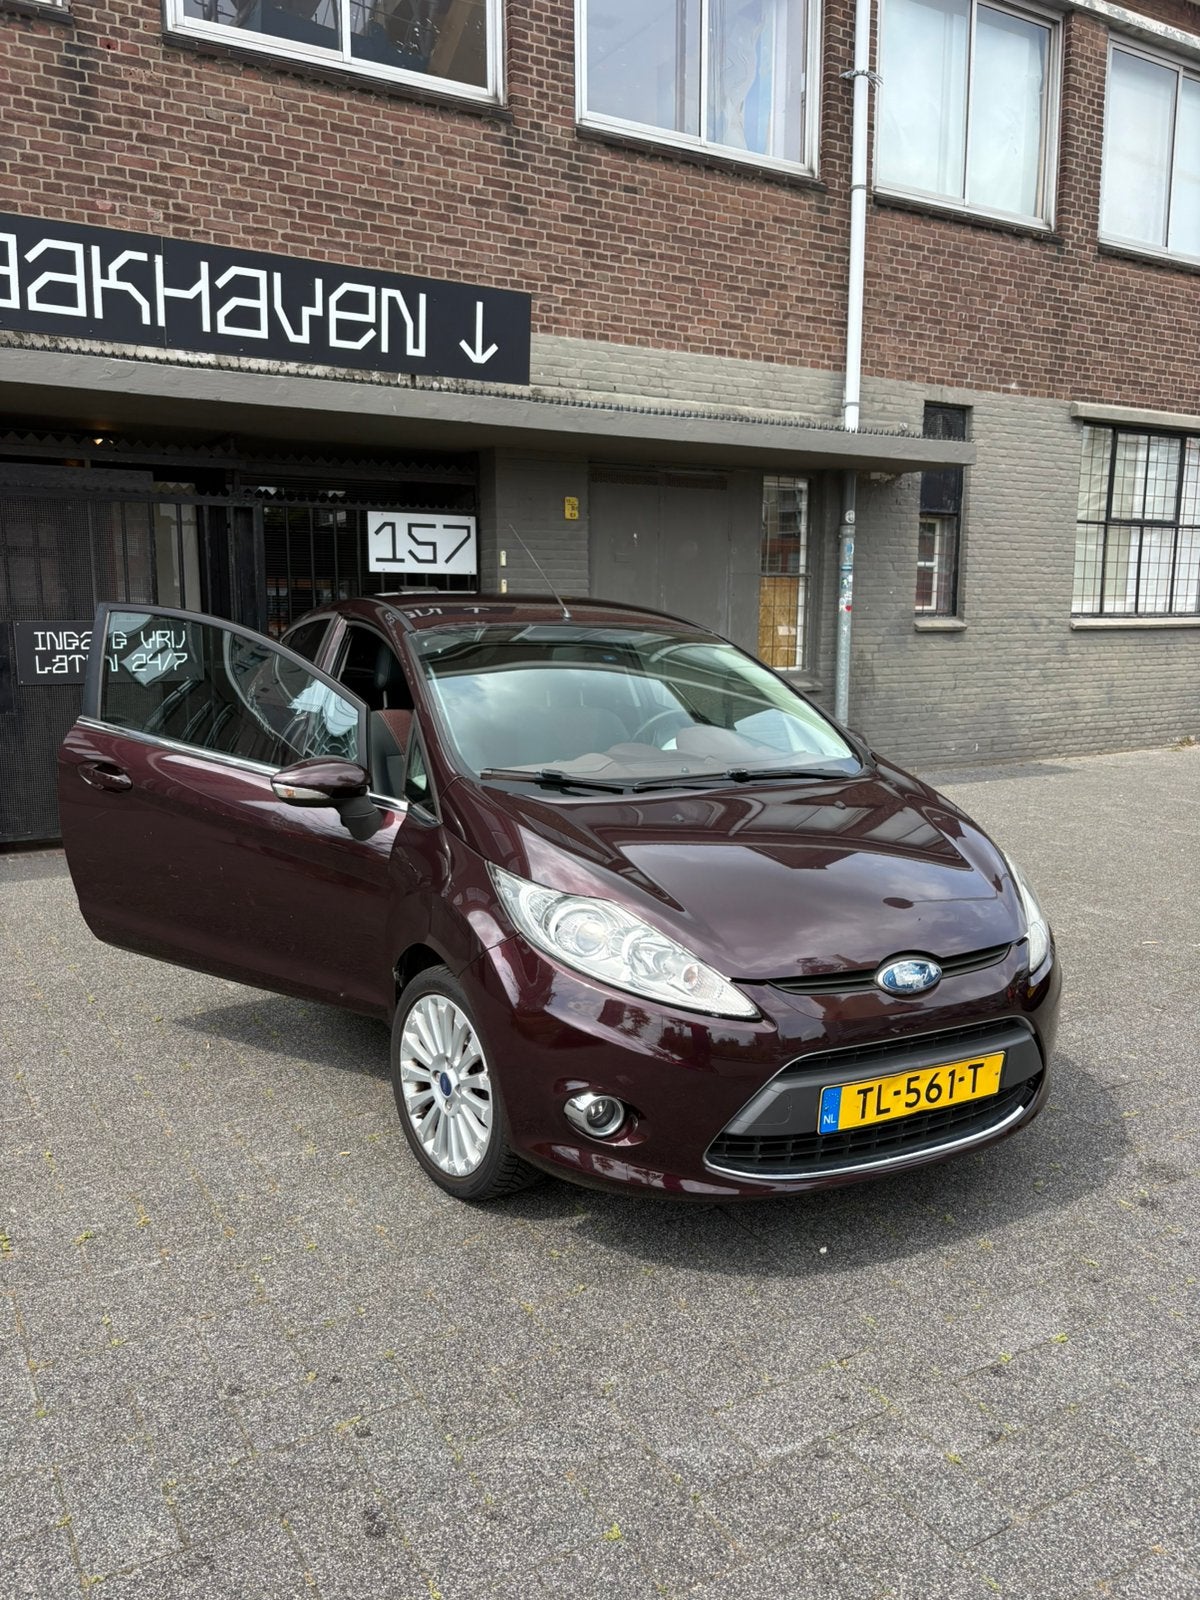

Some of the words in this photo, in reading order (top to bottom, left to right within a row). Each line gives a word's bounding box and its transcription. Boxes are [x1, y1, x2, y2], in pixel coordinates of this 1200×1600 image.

[374, 521, 471, 564] 157
[33, 630, 128, 650] INGaG
[35, 654, 119, 674] LaTN
[131, 652, 188, 672] 24/7
[857, 1062, 985, 1119] TL-561-T
[823, 1114, 836, 1125] NL
